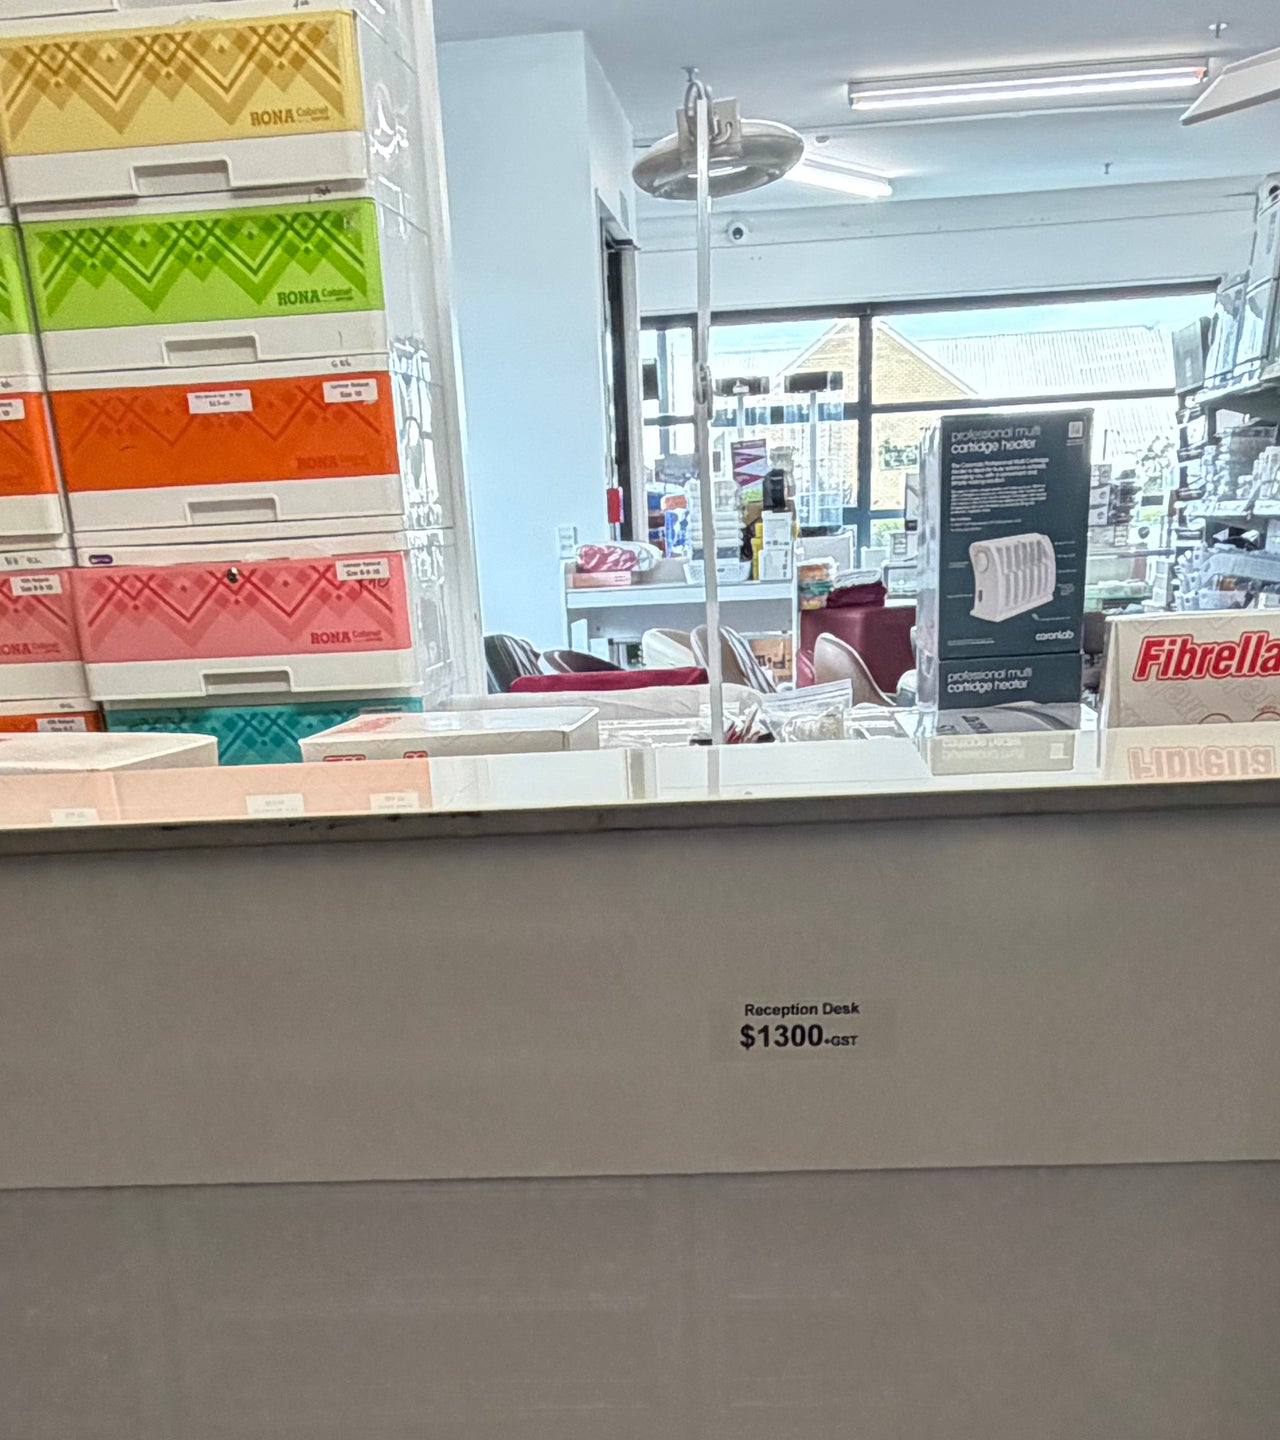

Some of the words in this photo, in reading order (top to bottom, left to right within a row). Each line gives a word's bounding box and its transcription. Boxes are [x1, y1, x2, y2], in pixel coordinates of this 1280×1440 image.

[951, 441, 999, 454] cartridge
[1001, 439, 1036, 451] heater
[948, 669, 1006, 683] professional
[947, 681, 993, 693] cartridge
[994, 680, 1028, 690] heater
[744, 1003, 818, 1018] Reception
[822, 1002, 861, 1015] Desk
